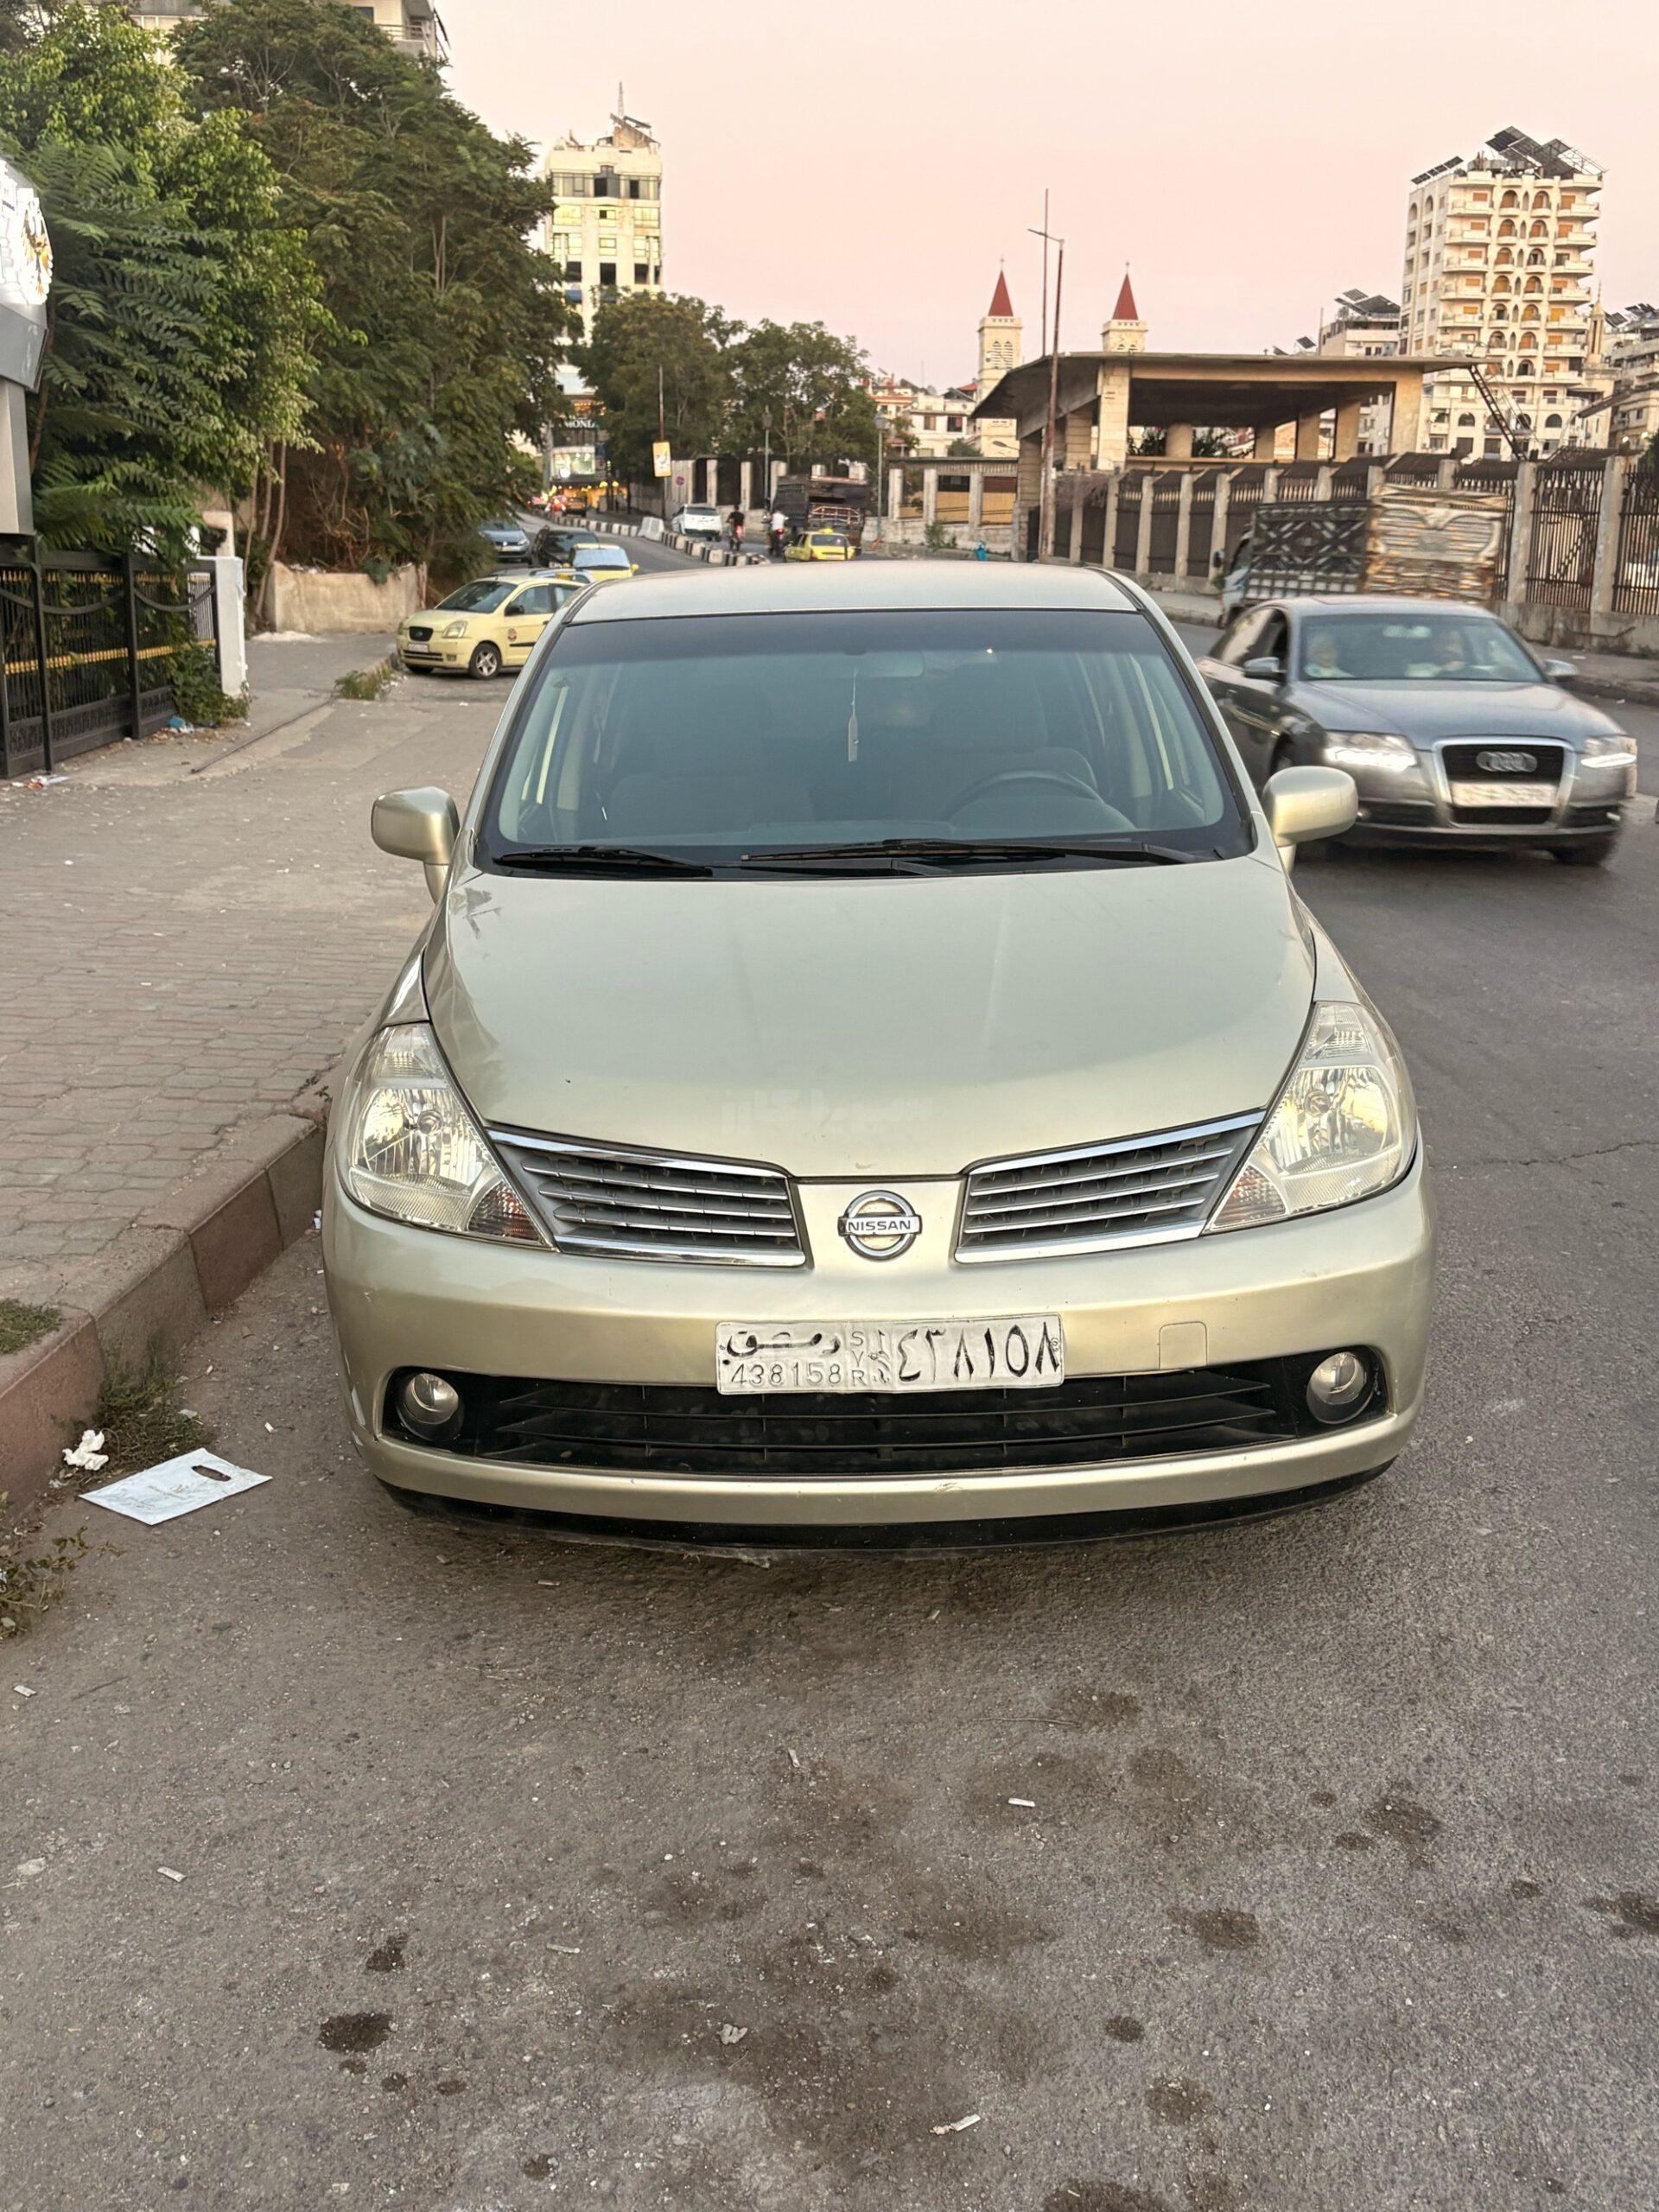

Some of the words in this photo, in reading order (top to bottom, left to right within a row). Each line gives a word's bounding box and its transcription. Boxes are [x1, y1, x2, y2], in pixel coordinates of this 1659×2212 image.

[847, 1219, 912, 1232] NISSAN
[897, 1320, 1060, 1384] ٤٣٨١٥٨
[729, 1361, 842, 1386] 438158
